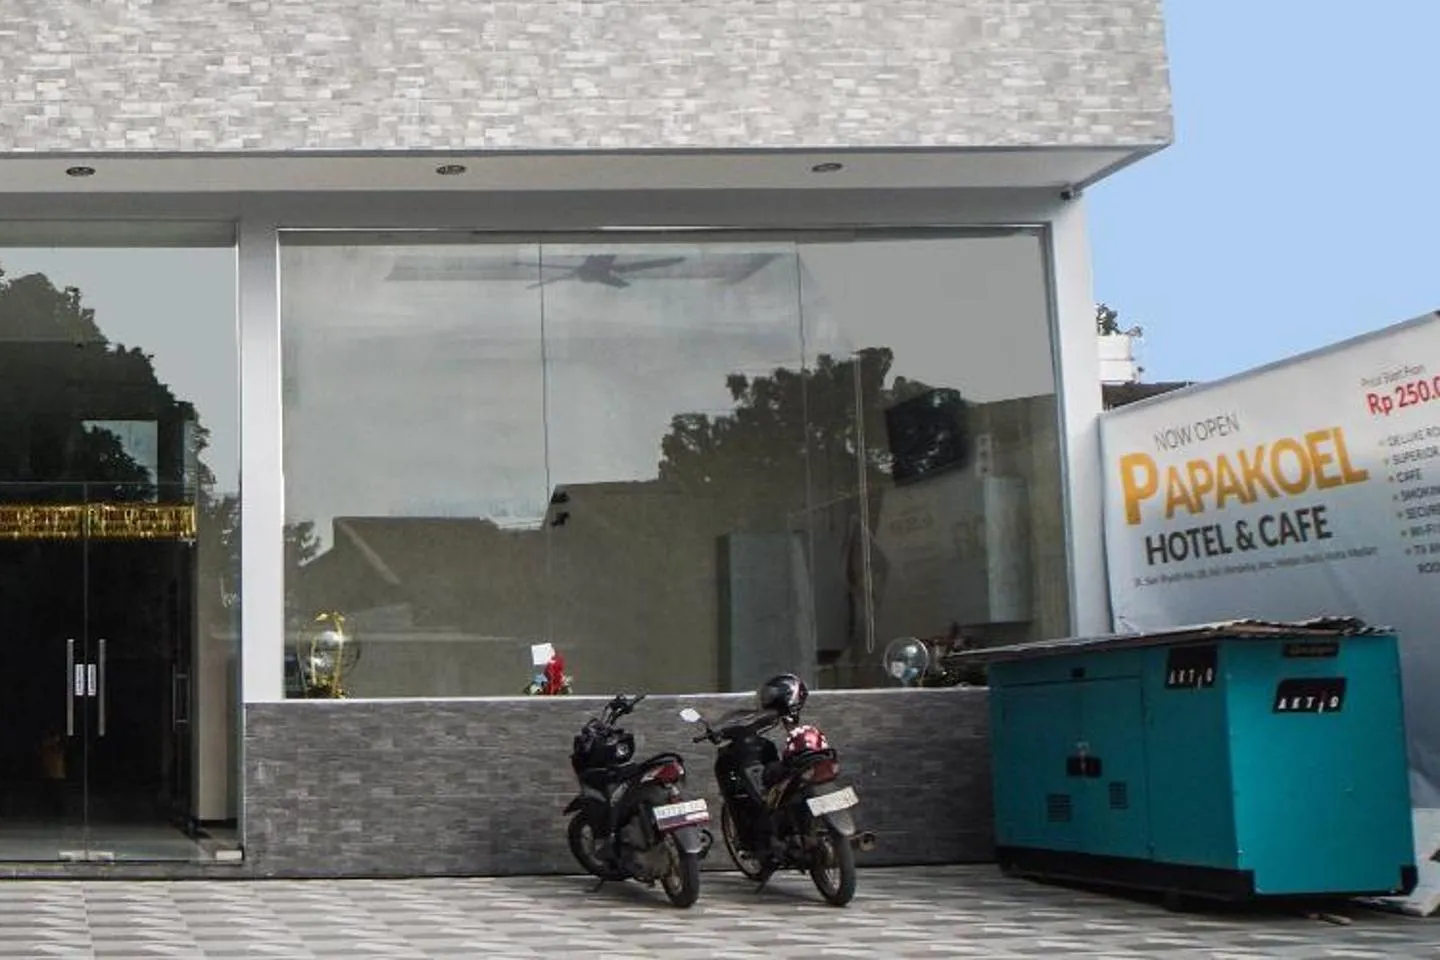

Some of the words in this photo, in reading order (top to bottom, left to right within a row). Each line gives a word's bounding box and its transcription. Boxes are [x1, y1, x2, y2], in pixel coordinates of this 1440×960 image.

[1367, 392, 1393, 416] Rp
[1153, 424, 1192, 452] NOW
[1193, 413, 1240, 442] OPEN
[1118, 425, 1370, 526] PAPAKOEL
[1395, 467, 1422, 484] CAFE
[1145, 524, 1233, 566] HOTEL
[1236, 520, 1258, 551] &
[1258, 505, 1333, 548] CAFE
